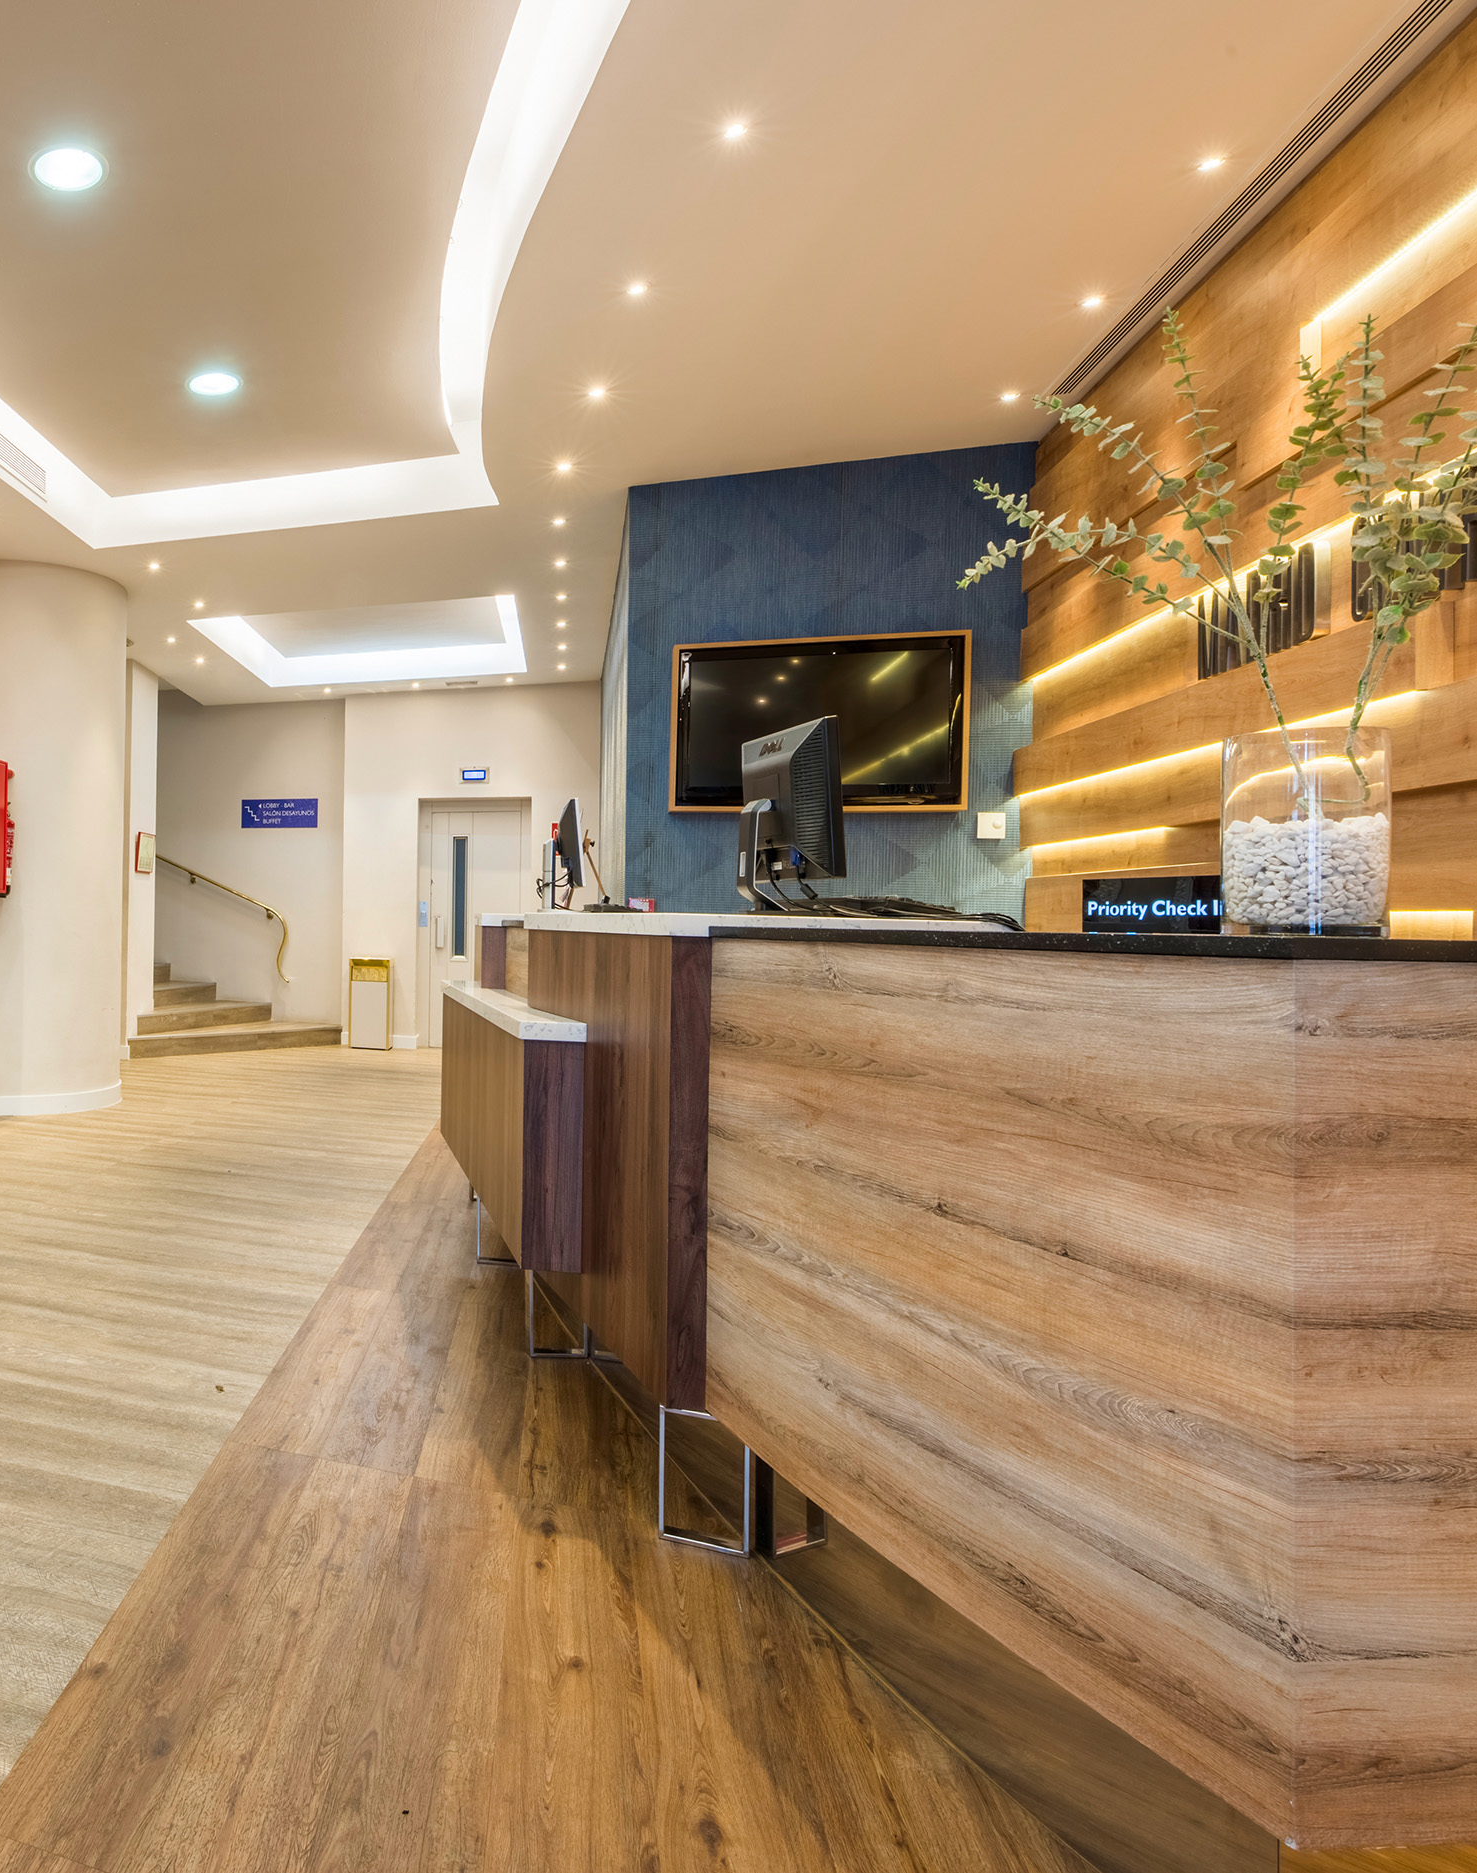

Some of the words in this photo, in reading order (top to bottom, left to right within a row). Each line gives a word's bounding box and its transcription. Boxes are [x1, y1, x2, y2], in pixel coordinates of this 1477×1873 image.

[758, 738, 784, 757] DELL
[1087, 900, 1148, 920] Priority
[1151, 899, 1208, 916] Check
